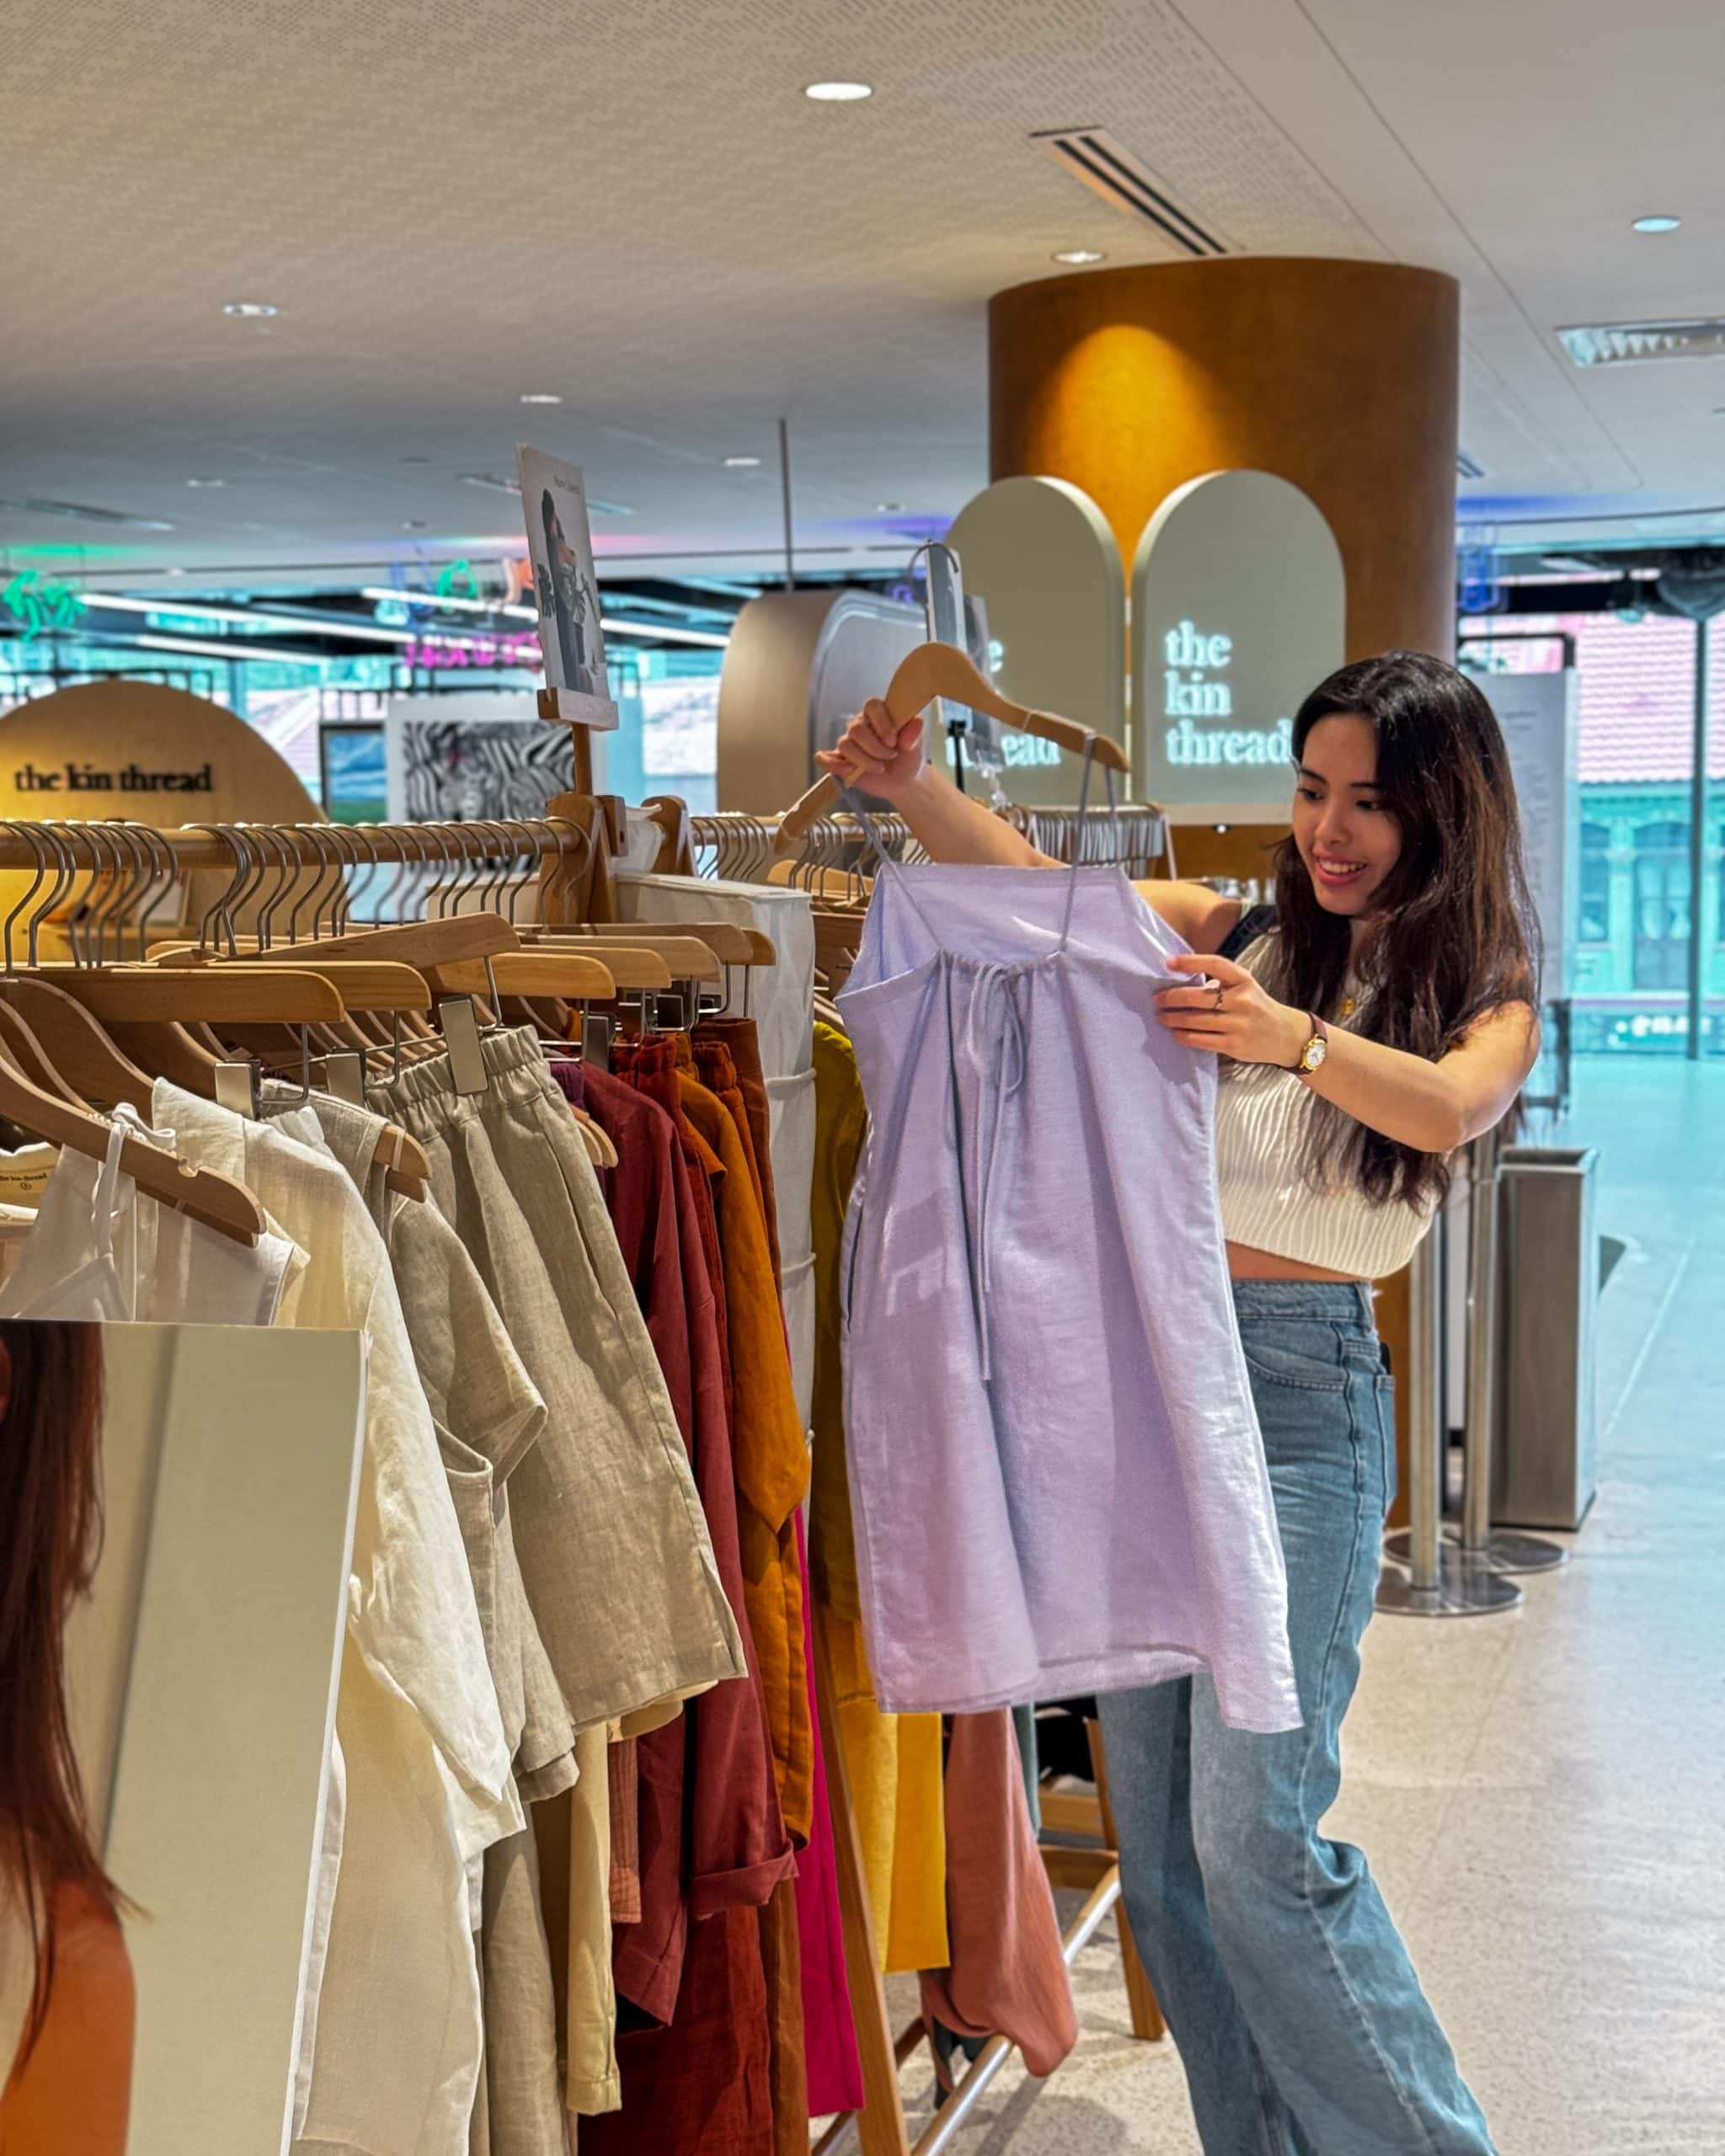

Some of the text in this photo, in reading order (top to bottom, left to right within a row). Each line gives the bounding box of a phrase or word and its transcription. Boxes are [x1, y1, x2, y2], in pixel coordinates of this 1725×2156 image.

[1165, 620, 1232, 667] the
[1165, 670, 1232, 716] kin
[1166, 718, 1293, 764] thread
[14, 762, 212, 792] the kin thread
